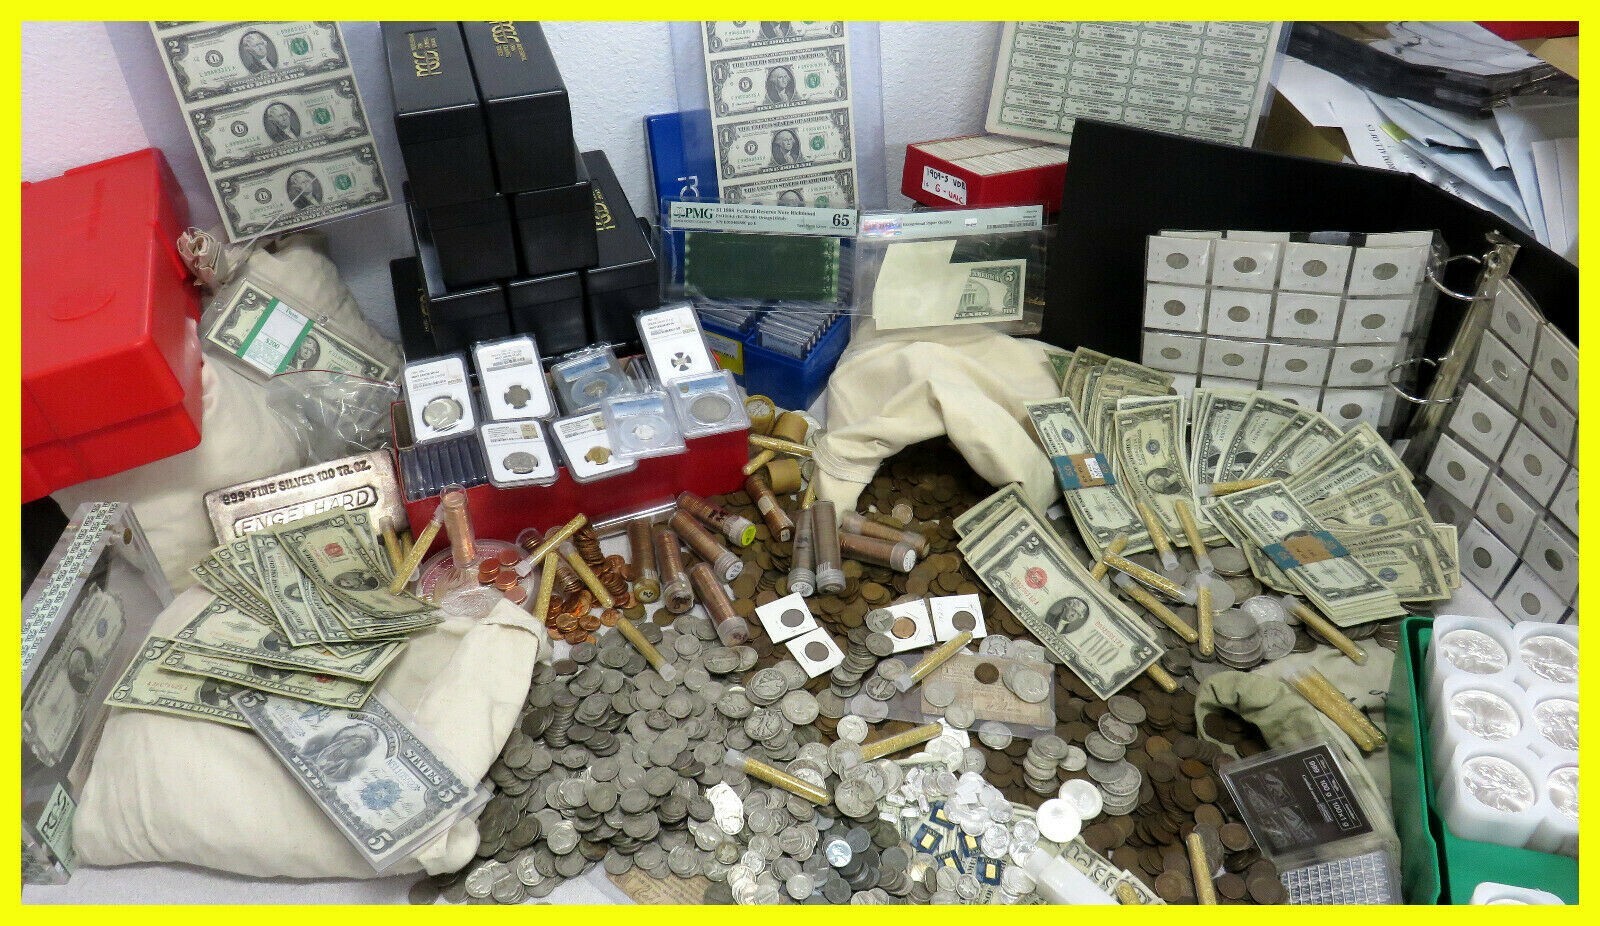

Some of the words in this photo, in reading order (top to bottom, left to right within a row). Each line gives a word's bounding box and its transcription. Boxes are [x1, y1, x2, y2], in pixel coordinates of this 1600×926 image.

[168, 40, 181, 53] 2
[195, 113, 207, 124] 2
[361, 147, 372, 158] 2
[220, 182, 232, 193] 2
[686, 208, 713, 220] PMG
[832, 214, 850, 227] 65
[1006, 271, 1014, 282] 5
[248, 292, 257, 304] 2
[279, 474, 315, 492] SILVER
[317, 469, 336, 480] 100
[1334, 467, 1362, 485] AMERICA
[1349, 492, 1379, 506] AMERICA
[1027, 537, 1040, 550] 2
[1138, 648, 1152, 659] 2
[113, 685, 132, 699] 5
[241, 692, 267, 707] 5
[292, 755, 324, 790] FIVE
[404, 749, 444, 786] STATES
[1309, 760, 1320, 774] 999
[438, 784, 462, 802] 5
[368, 832, 394, 850] 5
